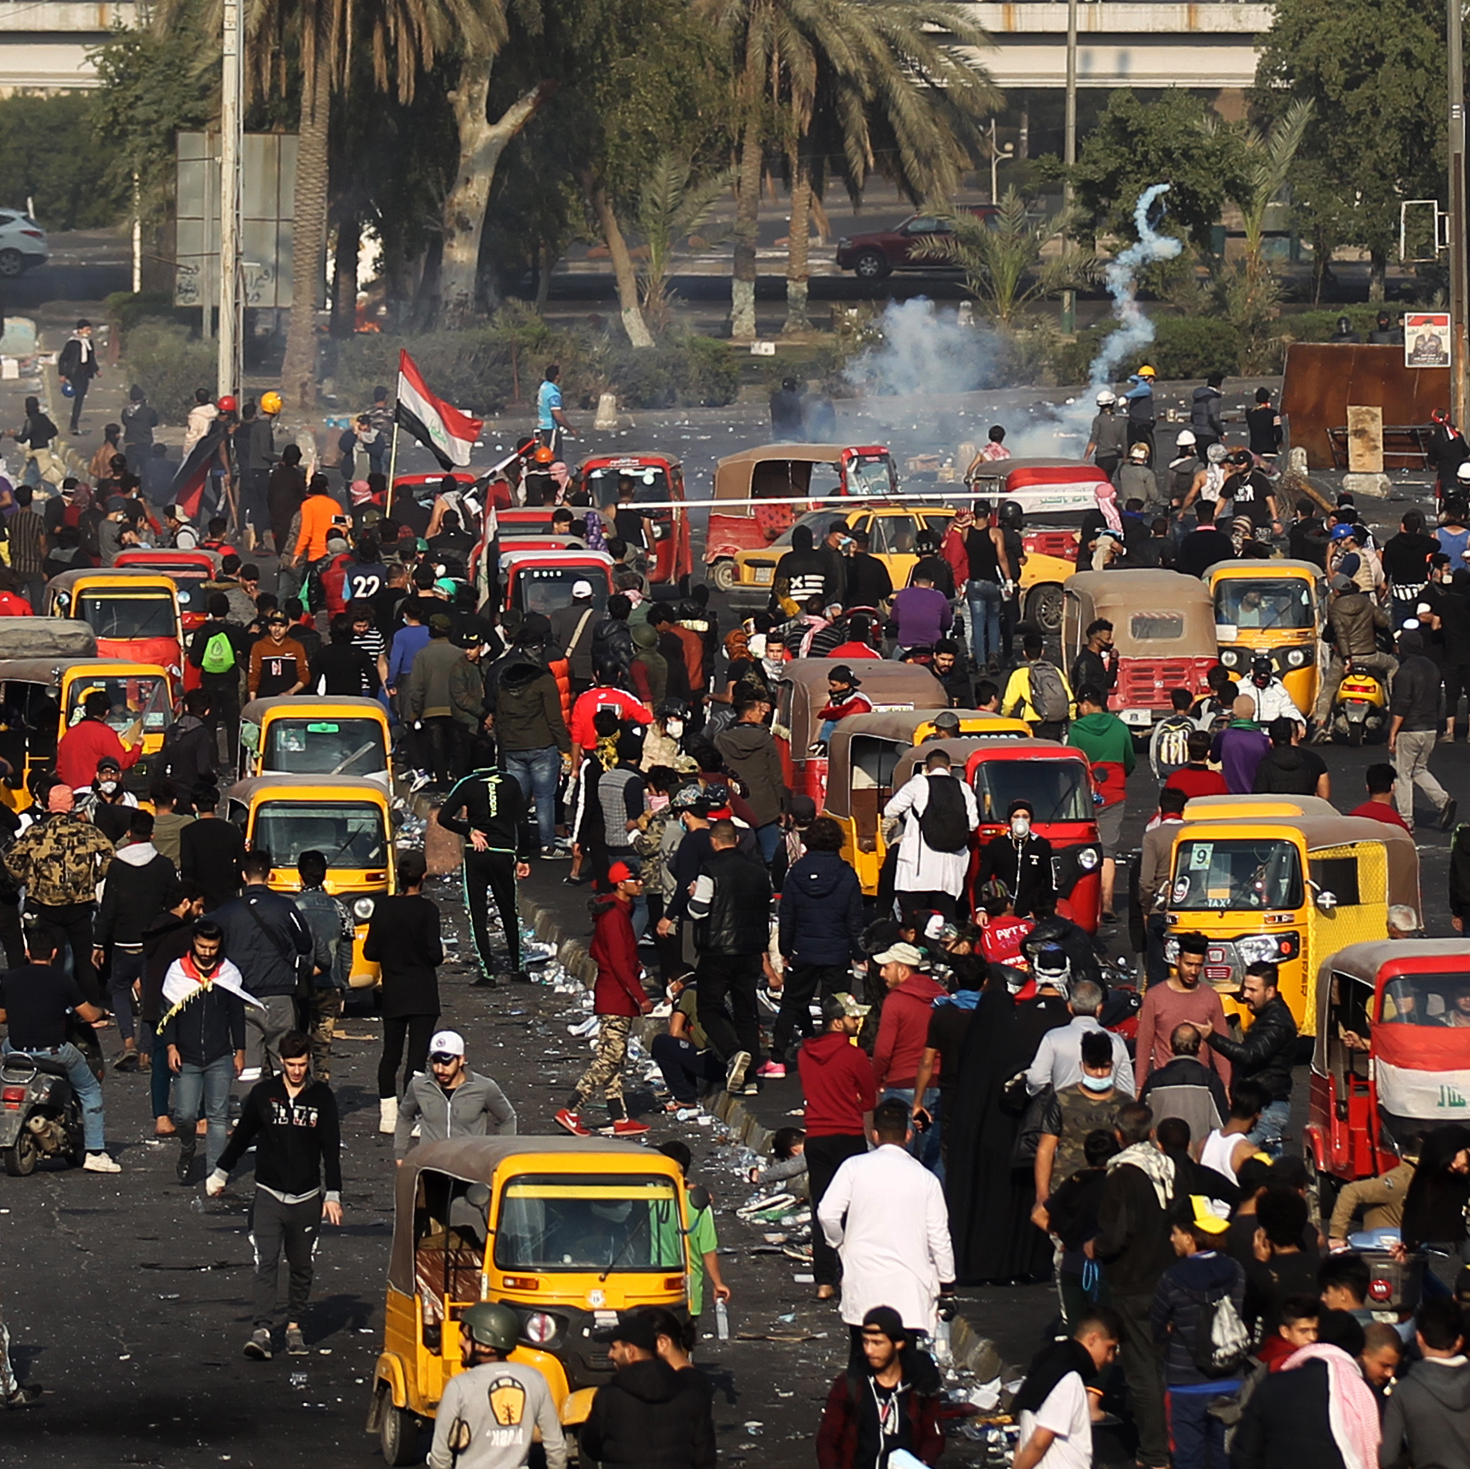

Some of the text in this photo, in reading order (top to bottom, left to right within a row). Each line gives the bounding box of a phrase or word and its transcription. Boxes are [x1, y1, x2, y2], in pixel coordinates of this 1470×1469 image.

[352, 575, 381, 599] 22
[487, 782, 498, 818] DIADORA
[1195, 848, 1208, 865] 9
